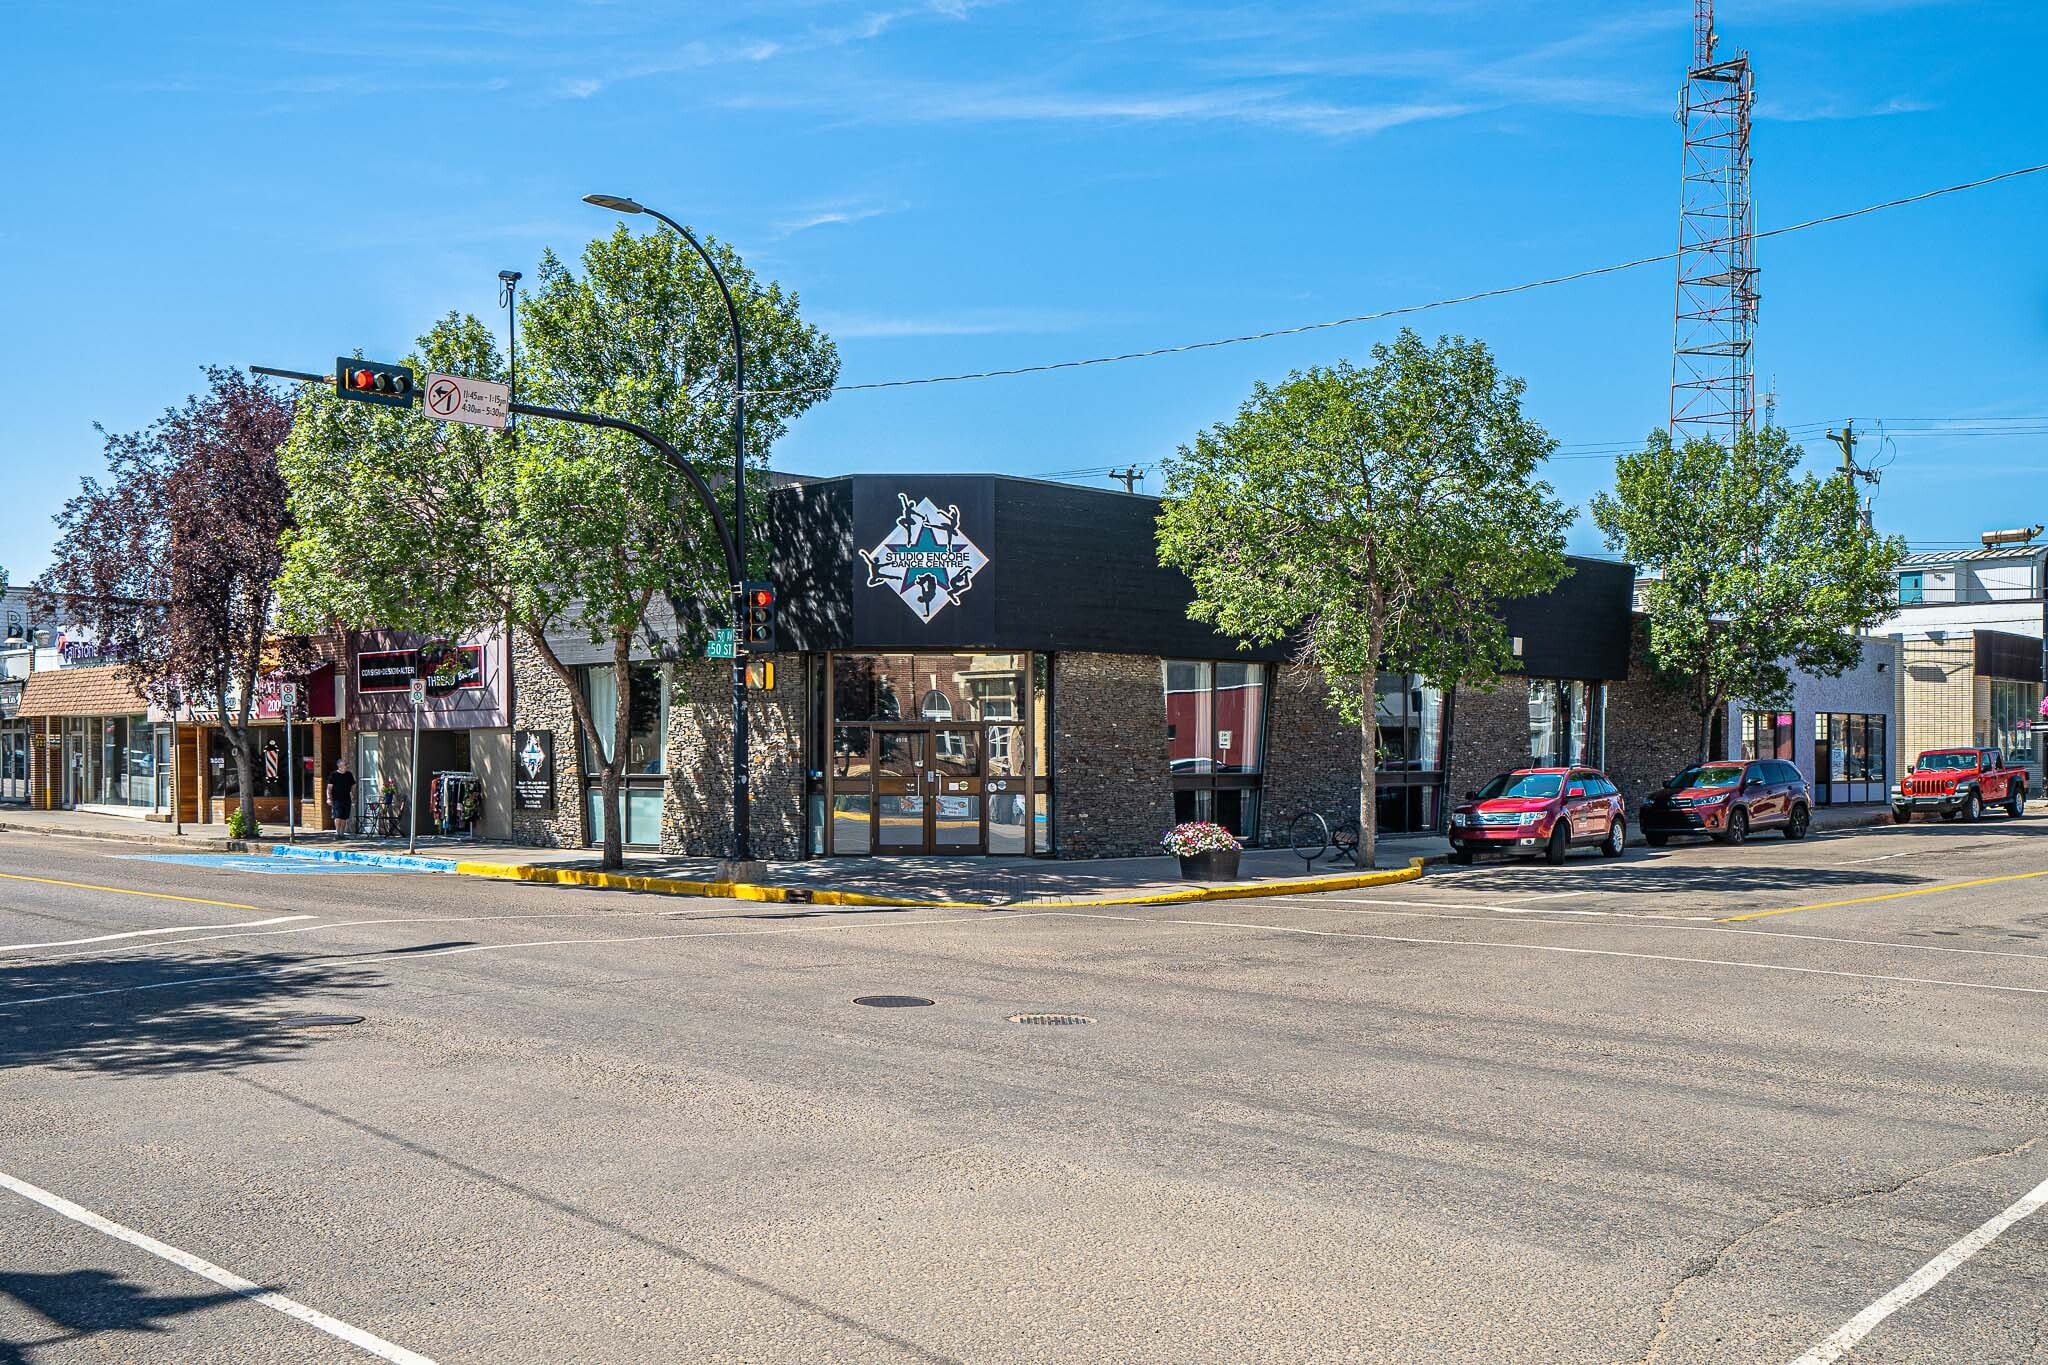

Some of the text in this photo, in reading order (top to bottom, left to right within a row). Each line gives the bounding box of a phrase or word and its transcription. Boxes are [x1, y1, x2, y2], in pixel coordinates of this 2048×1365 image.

[885, 552, 970, 561] STUDIO ENCORE
[892, 560, 963, 568] DANCE CENTRE
[717, 631, 726, 642] 50
[711, 643, 732, 655] 50 ST
